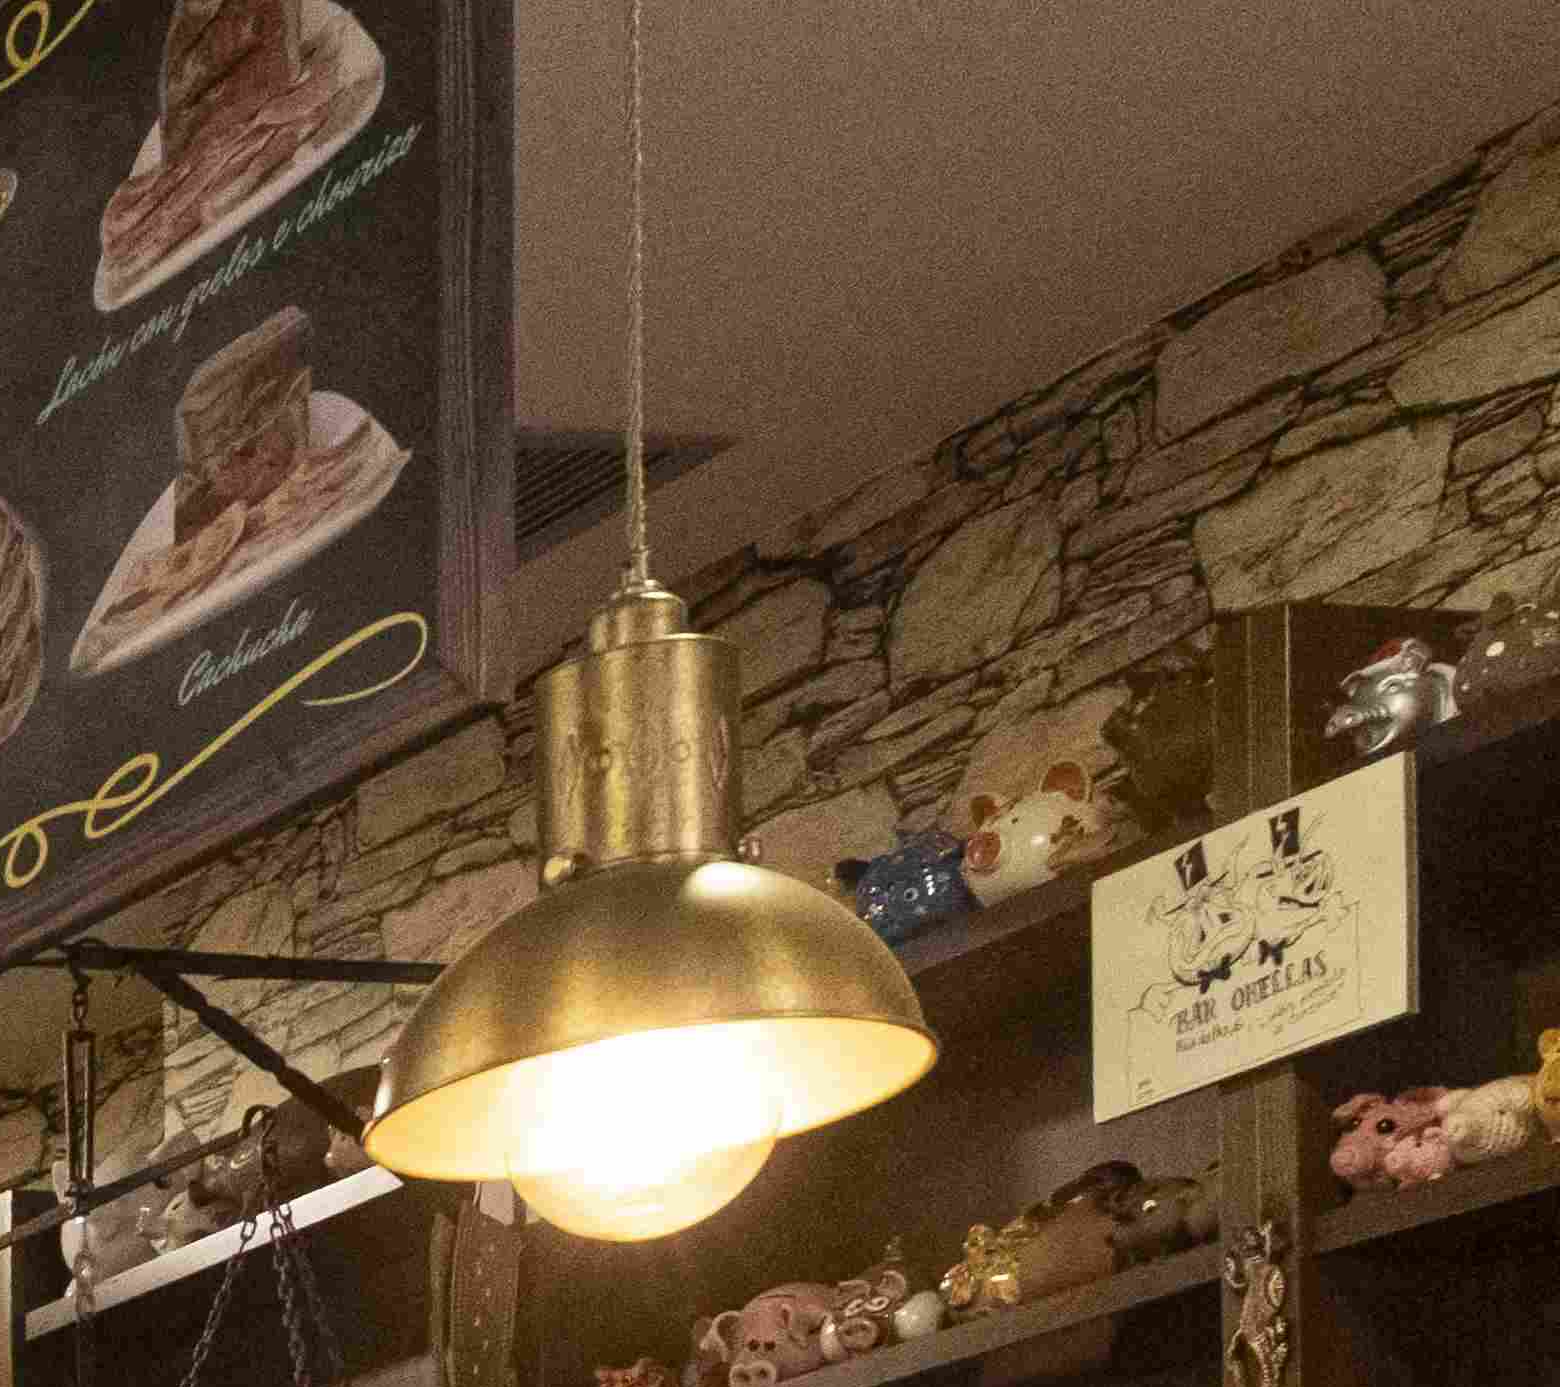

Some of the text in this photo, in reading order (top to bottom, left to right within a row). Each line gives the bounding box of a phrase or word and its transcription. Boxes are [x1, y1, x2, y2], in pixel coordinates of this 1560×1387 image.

[131, 303, 178, 352] con
[173, 234, 265, 344] grelos
[273, 219, 293, 251] e
[297, 122, 422, 233] chourizo
[1176, 997, 1218, 1035] BAR
[1231, 950, 1328, 1011] ORELLAS
